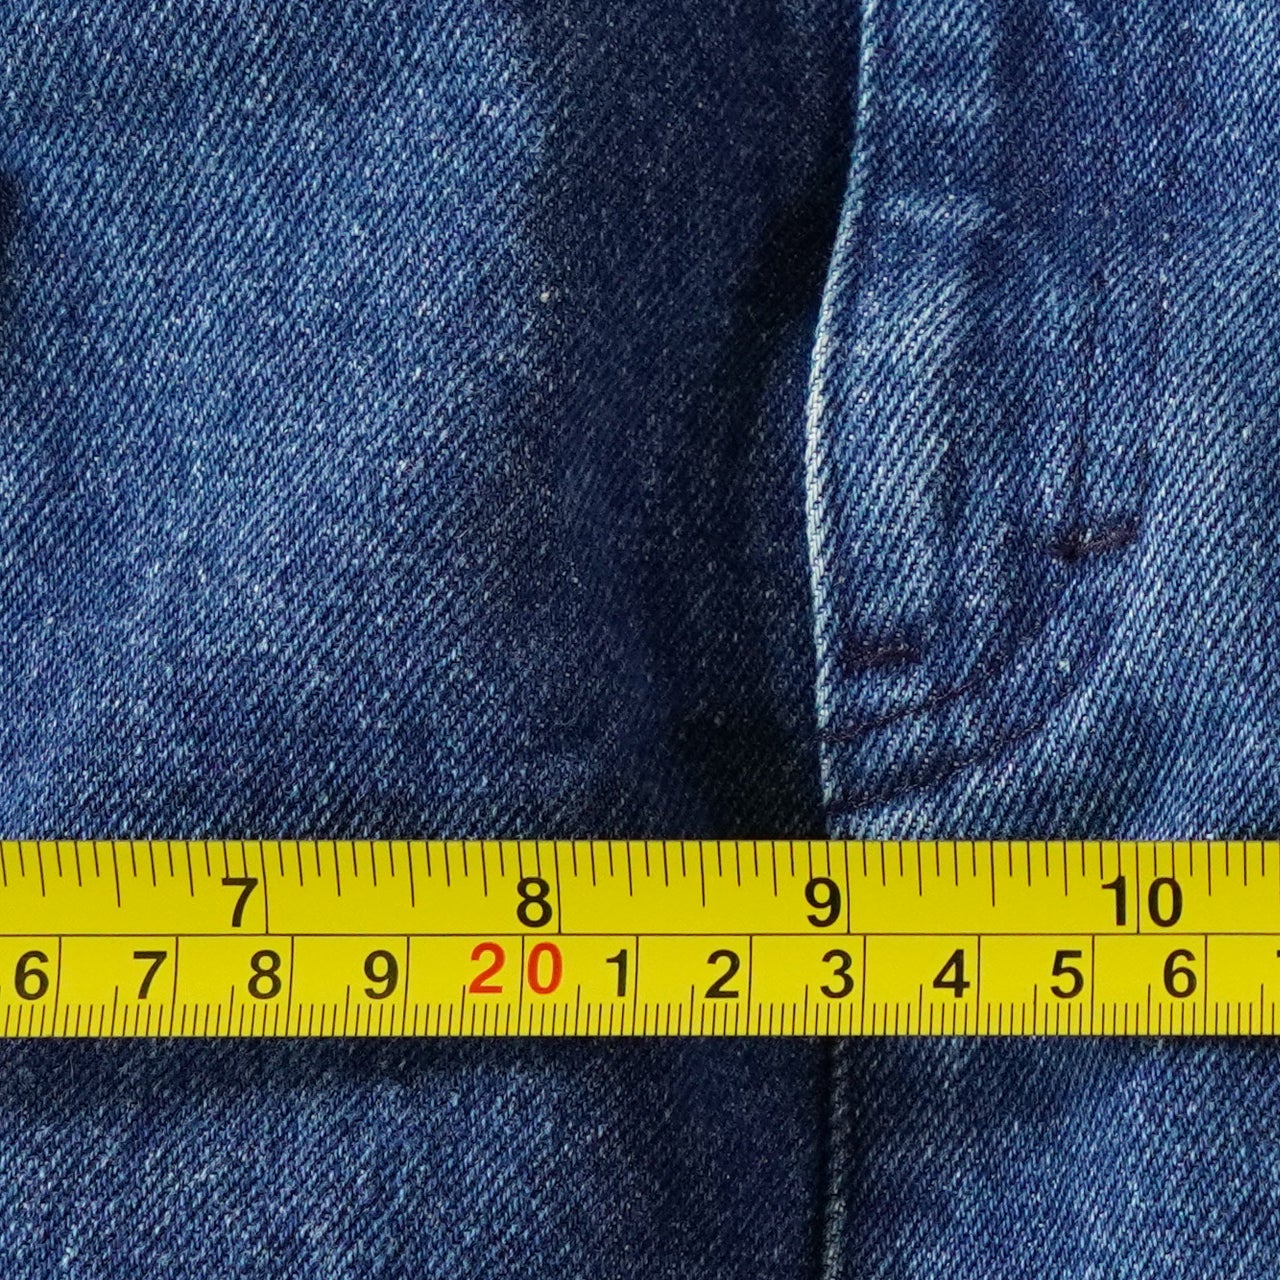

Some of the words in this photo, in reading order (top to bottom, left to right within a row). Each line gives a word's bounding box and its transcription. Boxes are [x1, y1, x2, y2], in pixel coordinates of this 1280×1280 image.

[222, 878, 257, 927] 7
[517, 878, 552, 928] 8
[805, 878, 841, 928] 9
[1102, 877, 1183, 928] 10
[15, 951, 48, 1000] 6
[134, 951, 167, 999] 7
[249, 950, 281, 999] 8
[365, 951, 398, 999] 9
[468, 942, 562, 995] 20
[607, 950, 628, 996] 1
[706, 950, 739, 998] 2
[821, 950, 853, 999] 3
[933, 950, 969, 997] 4
[1051, 951, 1083, 998] 5
[1164, 950, 1196, 998] 6
